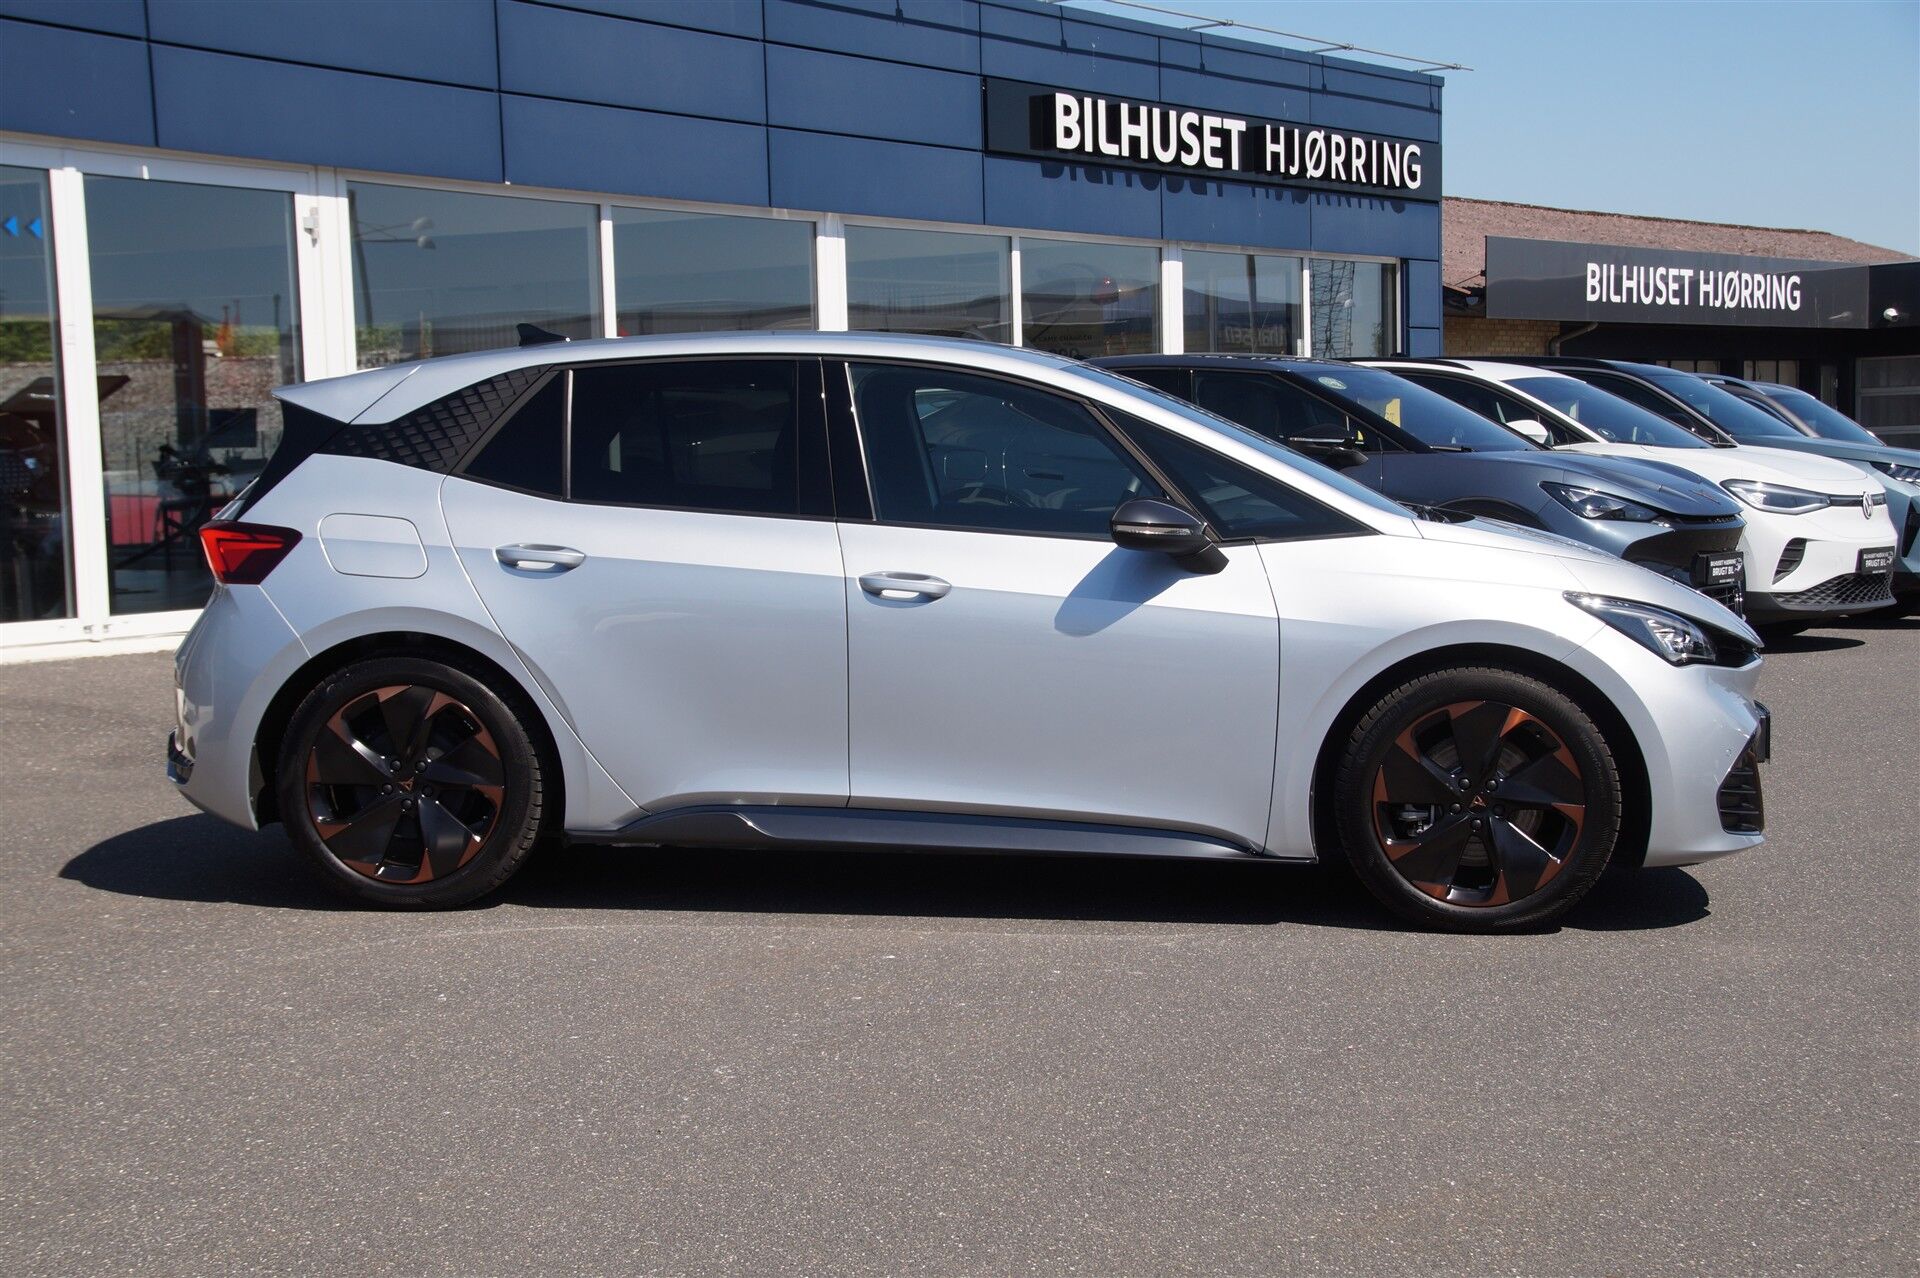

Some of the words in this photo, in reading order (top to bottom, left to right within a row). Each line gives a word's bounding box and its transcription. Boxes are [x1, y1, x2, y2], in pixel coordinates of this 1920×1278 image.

[1056, 93, 1246, 170] BILHUSET
[1266, 125, 1421, 189] HJØRRING
[1587, 263, 1693, 305] BILHUSET
[1700, 270, 1800, 310] HJØRRING
